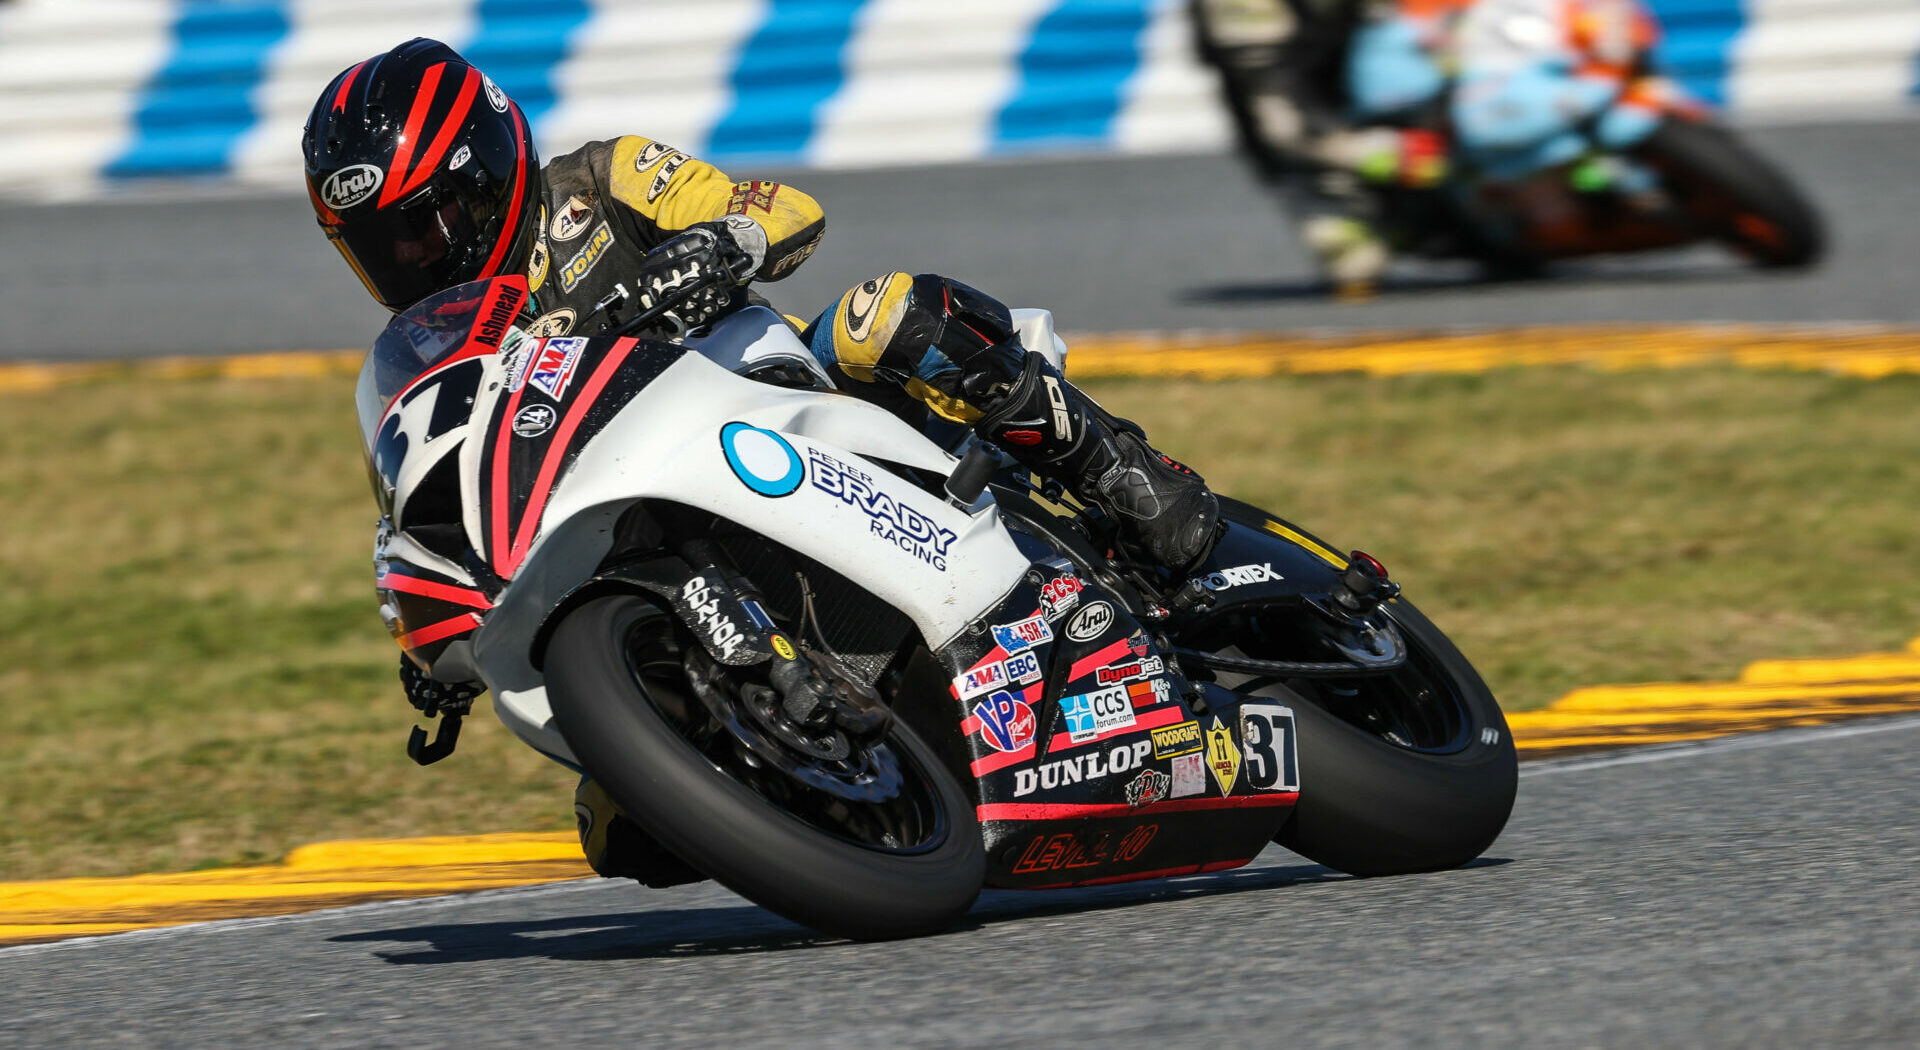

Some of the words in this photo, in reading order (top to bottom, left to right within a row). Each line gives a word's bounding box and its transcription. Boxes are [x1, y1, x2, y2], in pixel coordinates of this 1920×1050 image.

[328, 167, 375, 204] Arai
[565, 228, 609, 286] JOHN
[475, 284, 523, 347] Ashmead
[532, 339, 575, 392] AMA
[562, 338, 585, 370] RACING
[808, 446, 874, 486] PETER
[810, 457, 957, 557] BRADY
[870, 520, 947, 572] RACING
[1043, 575, 1076, 603] CCS
[682, 576, 745, 660] DUNLOP
[1018, 618, 1050, 643] ASRA
[1072, 604, 1109, 636] Arai
[964, 665, 1003, 693] AMA
[1006, 654, 1037, 679] EBC
[1099, 659, 1163, 683] Dynojet
[974, 690, 1016, 751] VP
[1093, 690, 1126, 718] CCS
[1096, 713, 1134, 729] forum.com
[1013, 740, 1152, 797] DUNLOP
[1245, 714, 1299, 789] 37
[1131, 773, 1163, 802] GPR
